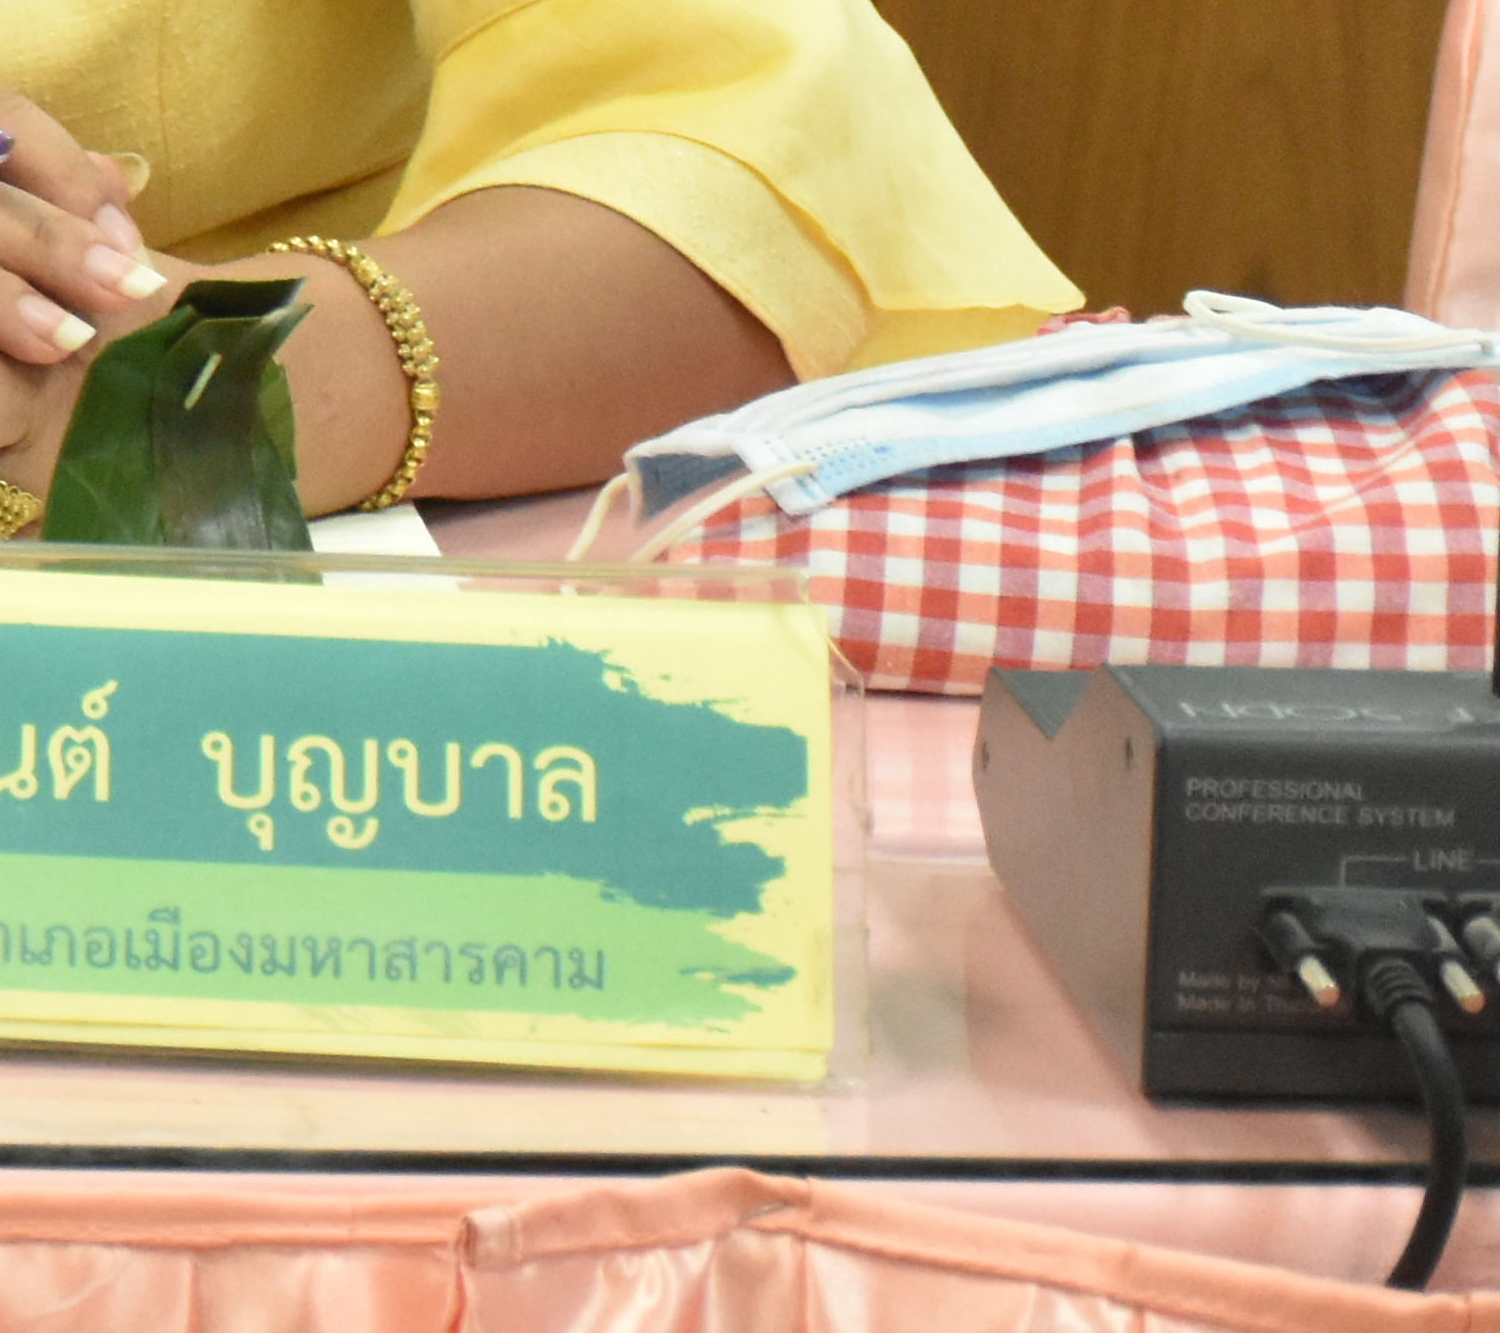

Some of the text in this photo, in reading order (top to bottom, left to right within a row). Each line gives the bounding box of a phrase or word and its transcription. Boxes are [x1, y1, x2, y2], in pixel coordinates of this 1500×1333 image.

[201, 730, 597, 851] บุญบาล
[1185, 777, 1363, 801] PROFESSIONAL
[1184, 801, 1455, 828] CONFERENCE SYSTEM
[1413, 848, 1474, 873] LINE
